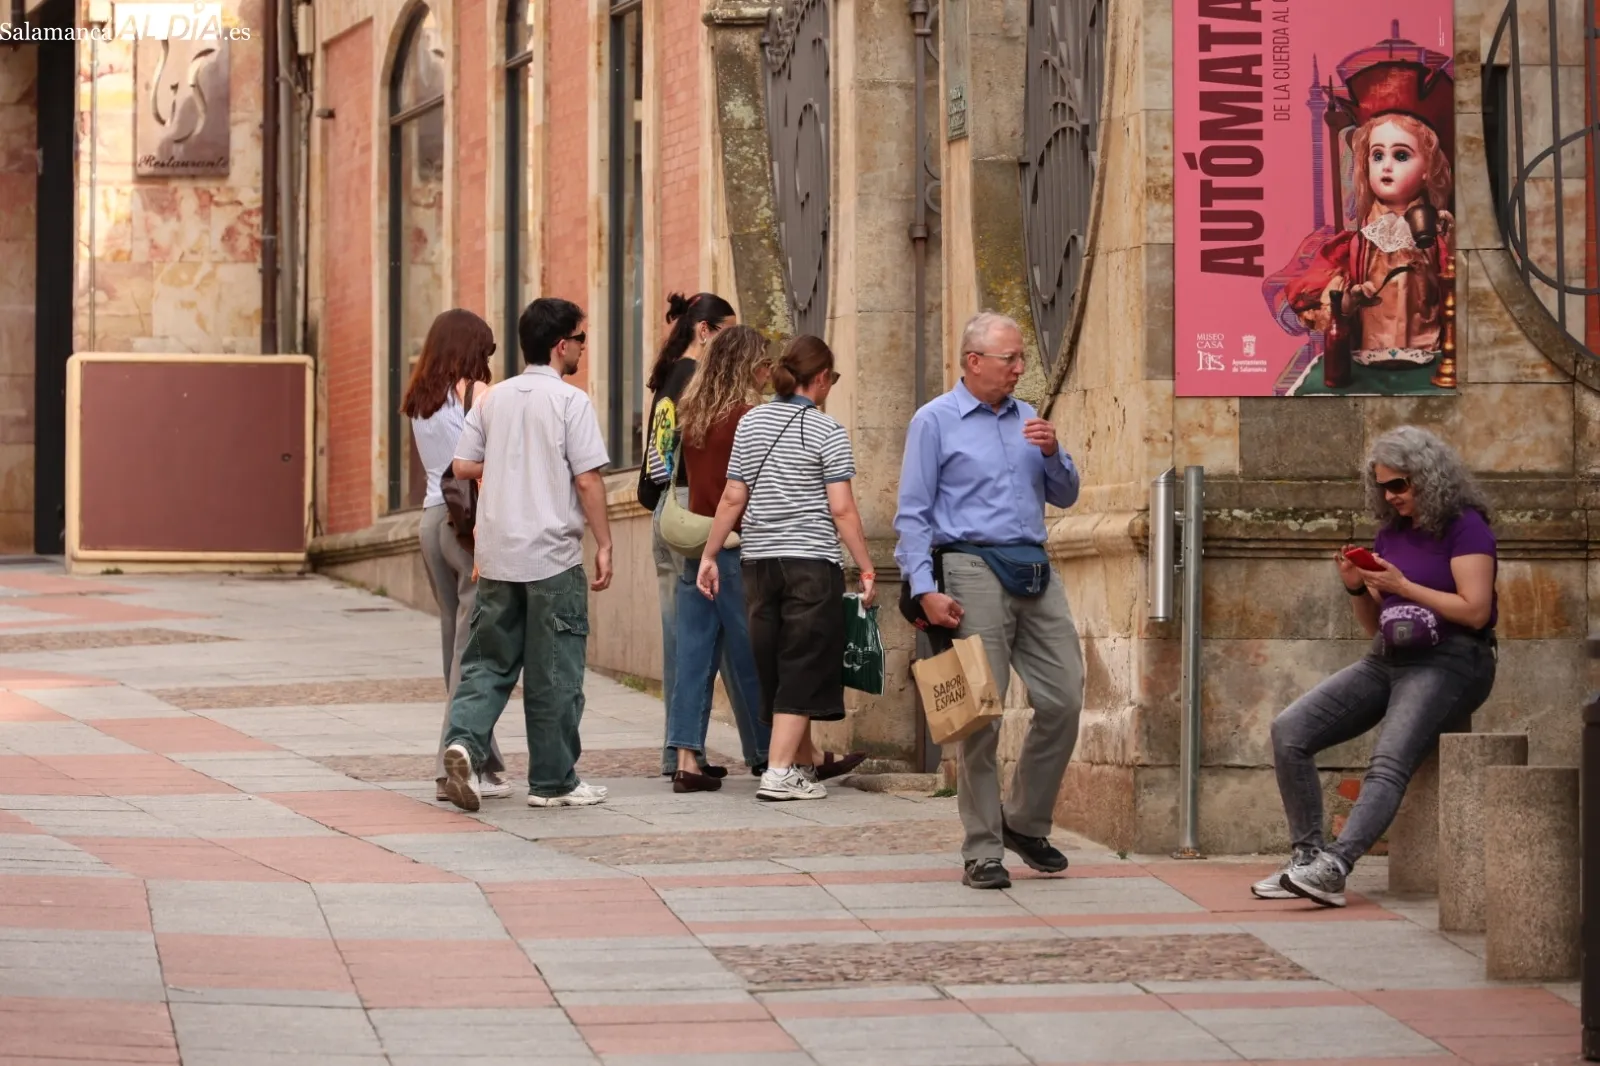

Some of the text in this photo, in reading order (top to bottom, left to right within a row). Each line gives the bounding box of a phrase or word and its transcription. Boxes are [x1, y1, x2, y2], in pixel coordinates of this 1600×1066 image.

[1272, 7, 1289, 23] AL
[1272, 27, 1290, 80] CUERDA
[1273, 83, 1290, 100] LA
[1273, 104, 1290, 121] DE
[1182, 0, 1264, 278] AUTÓMATA
[138, 155, 230, 168] Restaurante
[1196, 333, 1225, 341] MUSEO
[1196, 341, 1224, 349] CASA
[1232, 359, 1267, 367] Ayuntamiento
[933, 674, 962, 699] SABOR
